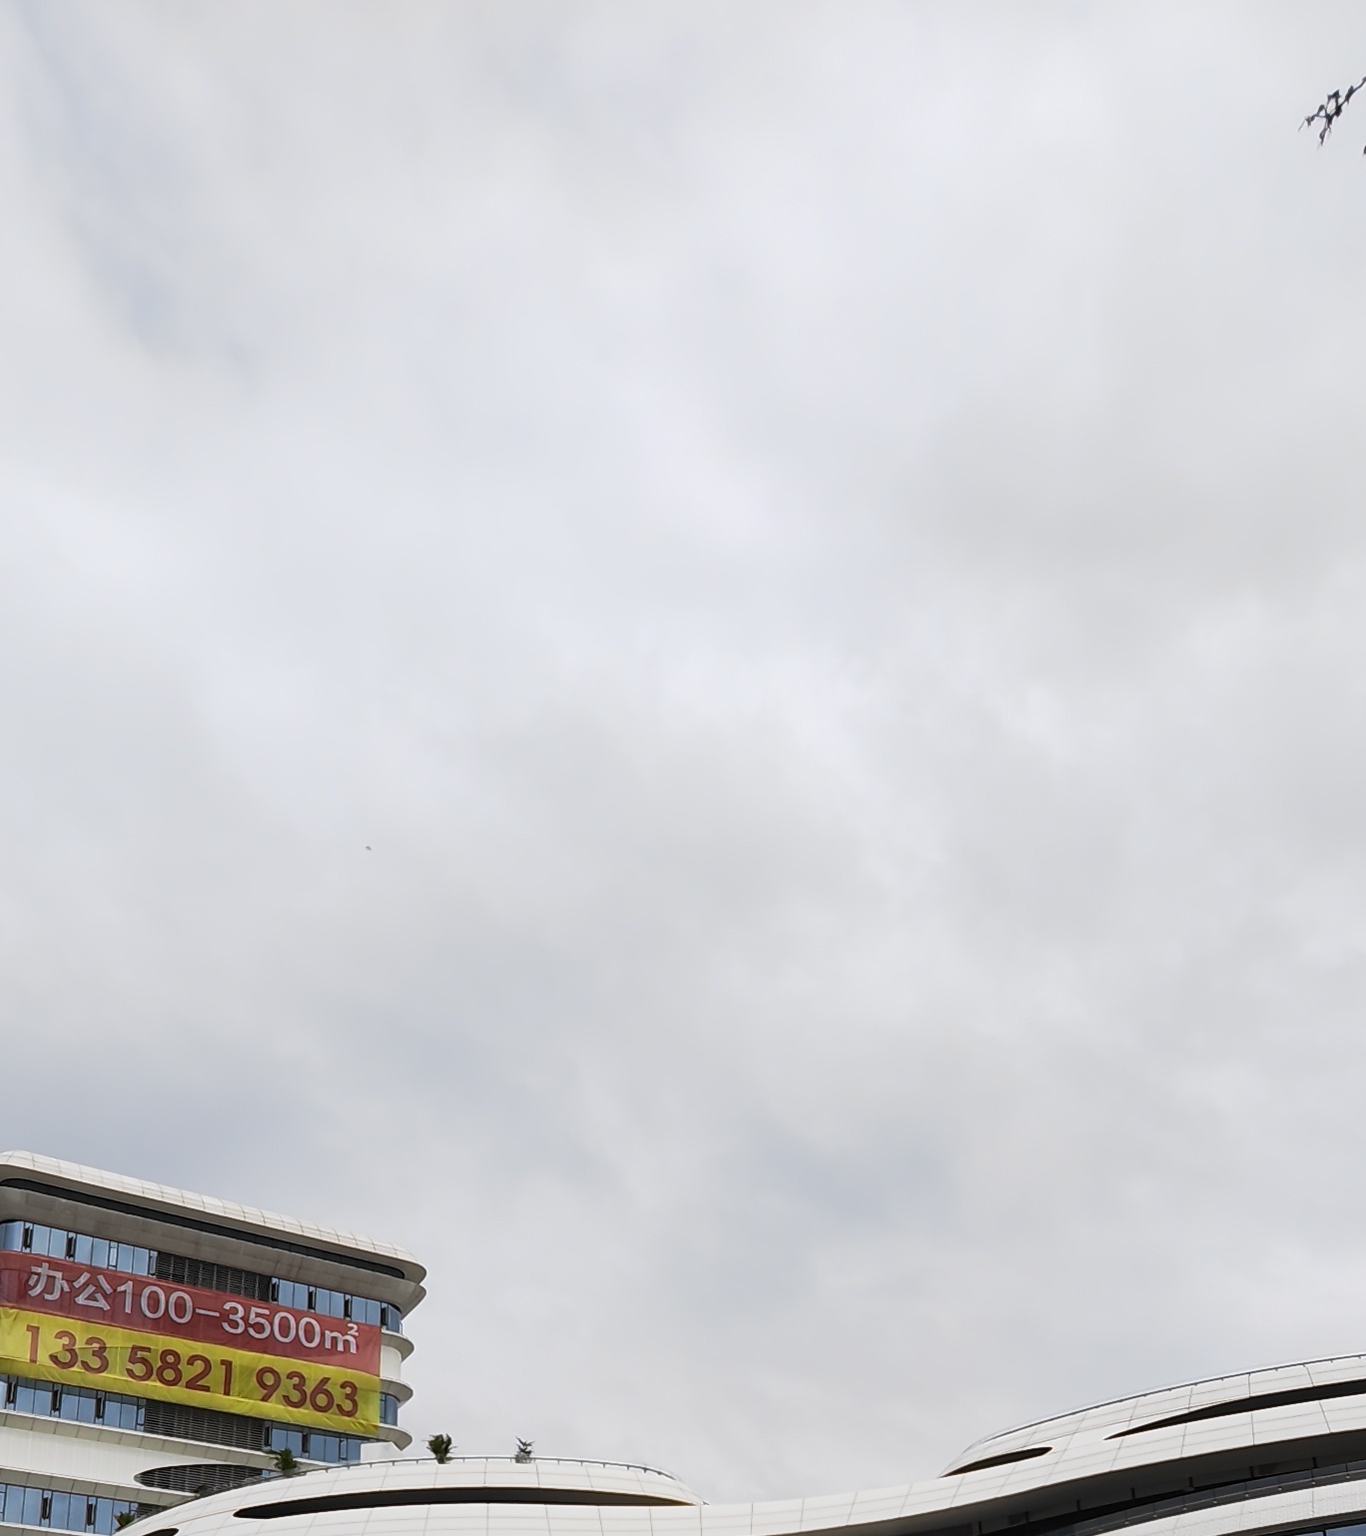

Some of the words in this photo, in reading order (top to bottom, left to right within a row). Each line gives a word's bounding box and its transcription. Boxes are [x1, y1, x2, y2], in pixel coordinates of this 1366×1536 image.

[26, 1323, 110, 1375] 133
[125, 1344, 233, 1397] 5821
[255, 1366, 359, 1417] 9363
